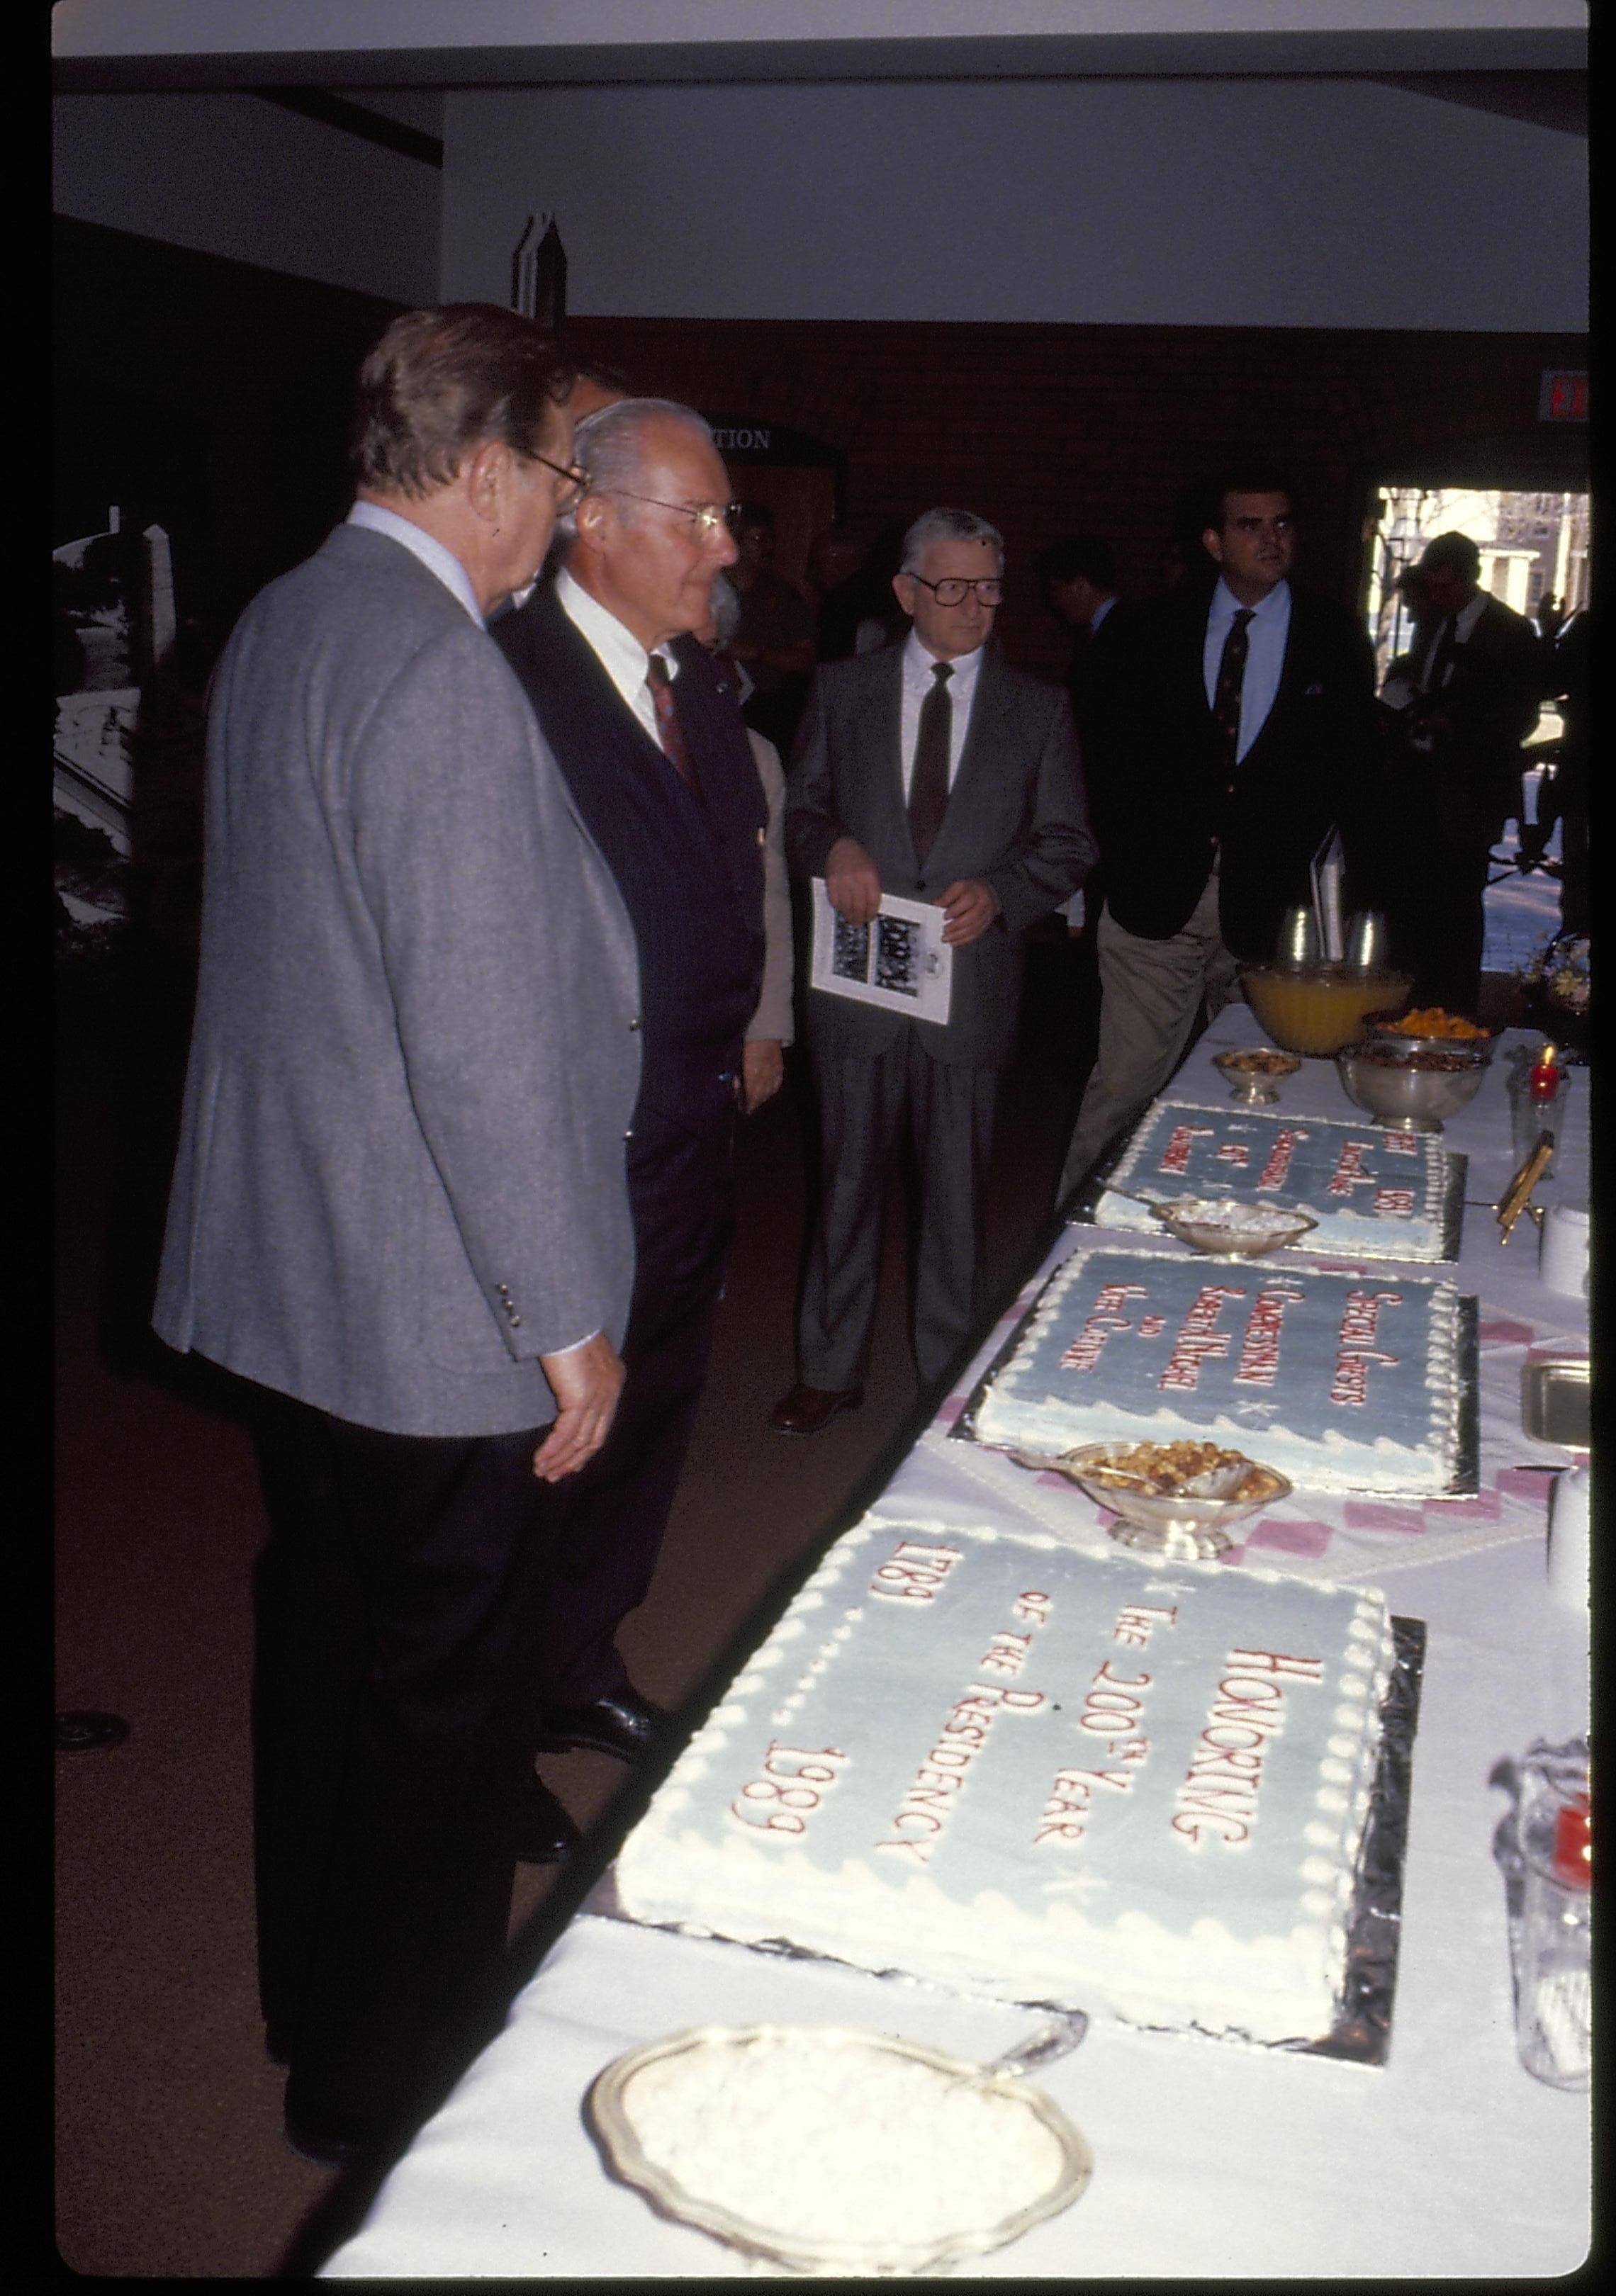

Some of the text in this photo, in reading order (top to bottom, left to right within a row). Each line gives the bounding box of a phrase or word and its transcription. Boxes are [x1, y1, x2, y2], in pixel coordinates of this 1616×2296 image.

[714, 428, 770, 447] TION
[1060, 1282, 1148, 1372] WIFE CORINNE
[1138, 1314, 1167, 1337] AND
[1157, 1341, 1228, 1392] MICHEL
[1233, 1288, 1306, 1386] CONGRESSMAN
[1330, 1290, 1403, 1405] SPECIAL GUESTS
[1113, 1604, 1178, 1646] THE
[731, 1540, 963, 1834] 1789 1989
[872, 1590, 1050, 1864] OF THE PRESIDENCY
[1171, 1648, 1324, 1844] HONORING
[1033, 1767, 1131, 1844] YEAR
